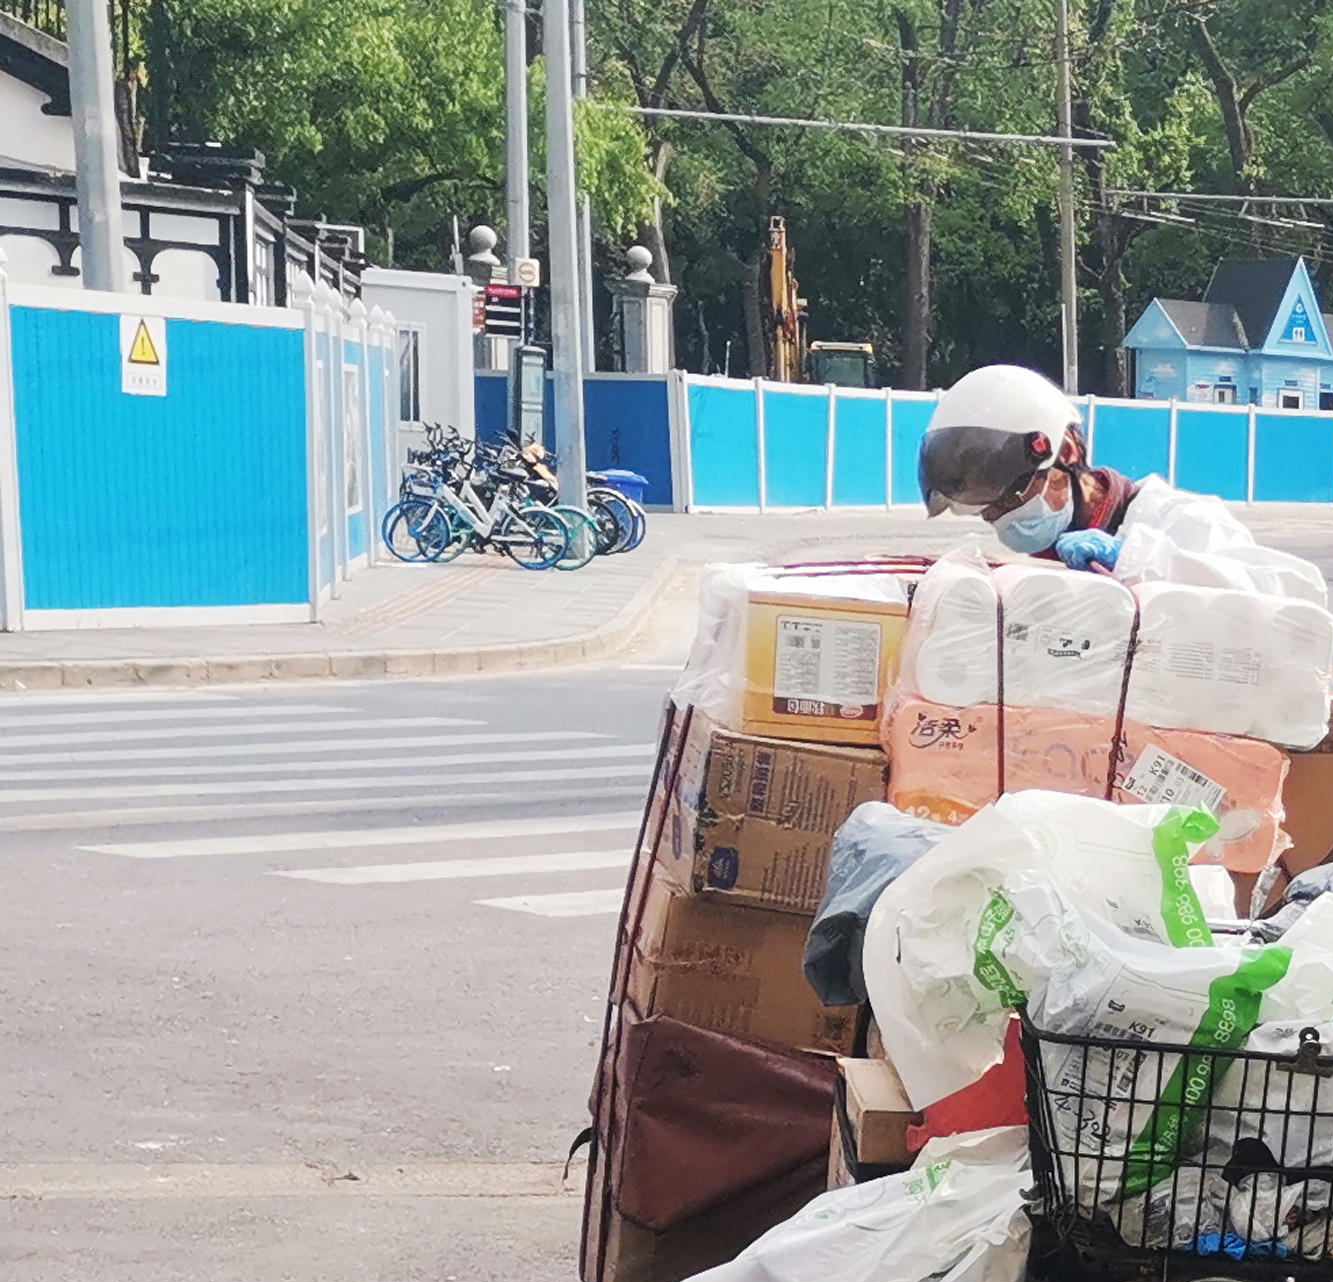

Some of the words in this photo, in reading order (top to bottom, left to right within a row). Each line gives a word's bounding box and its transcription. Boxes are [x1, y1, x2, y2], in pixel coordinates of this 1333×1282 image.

[910, 714, 964, 741] 洁柔
[1149, 755, 1166, 776] K91
[1128, 1021, 1156, 1038] K91
[1215, 999, 1236, 1043] 8898
